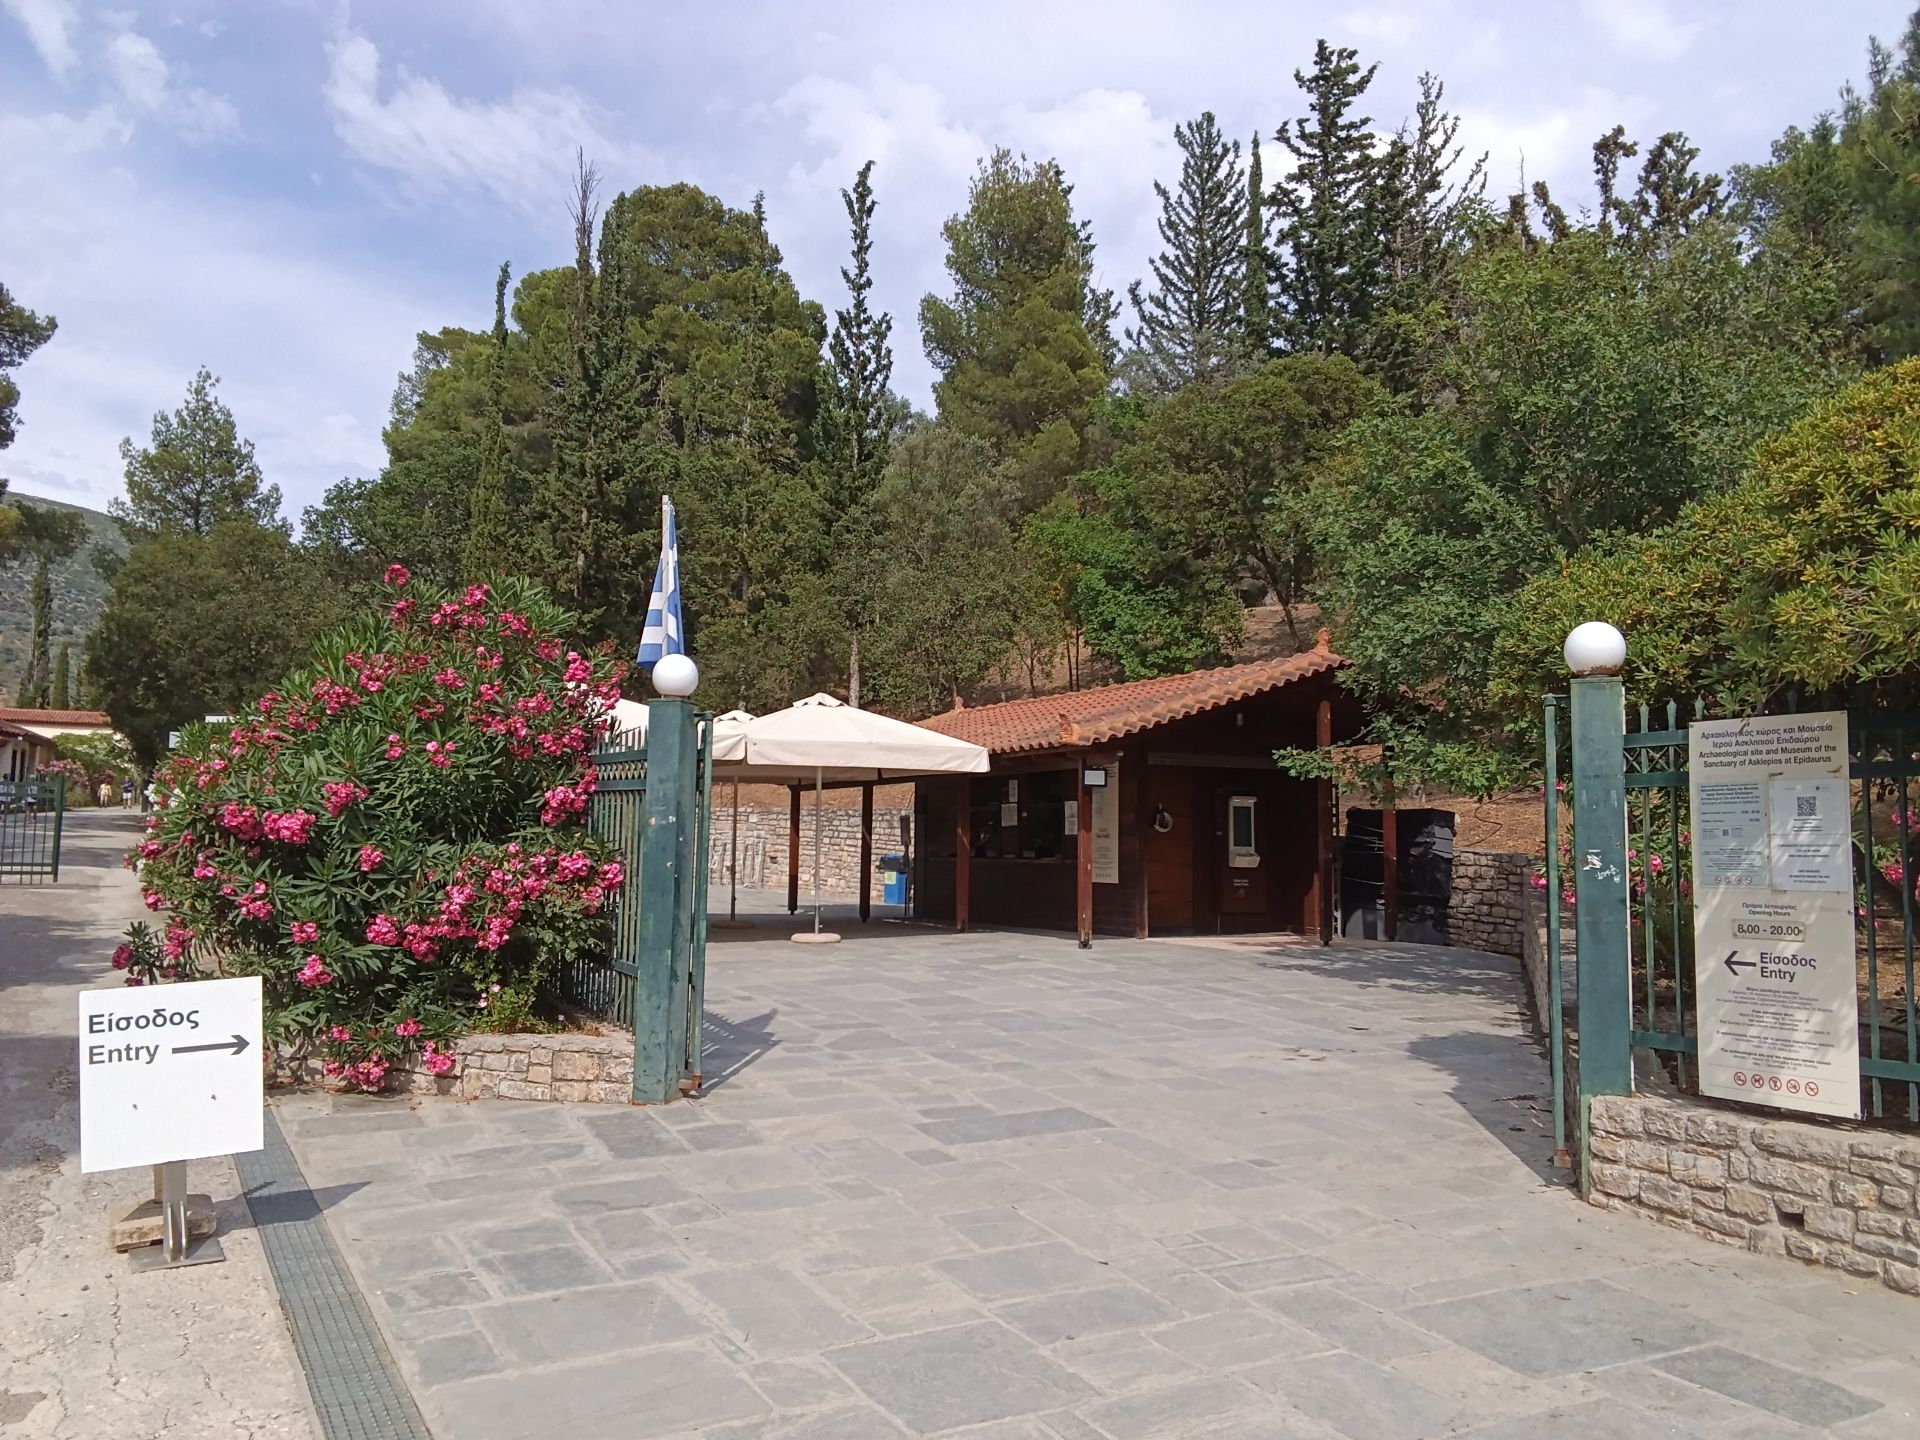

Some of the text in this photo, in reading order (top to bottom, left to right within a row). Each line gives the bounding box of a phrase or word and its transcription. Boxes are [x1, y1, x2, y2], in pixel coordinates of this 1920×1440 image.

[1755, 727, 1781, 736] χώρος
[1797, 724, 1833, 733] Μουσείο
[1712, 735, 1820, 749] Ιερού Ασκληπιού Επιδαύρου
[1699, 750, 1749, 759] Archaeological
[1780, 746, 1813, 755] Museum
[1814, 745, 1823, 753] of
[1823, 744, 1837, 752] the
[1703, 760, 1737, 769] Sanctuary
[1747, 757, 1783, 767] Asklepios
[1784, 756, 1793, 764] at
[1793, 755, 1832, 765] Epidaurus
[1748, 909, 1773, 917] Opening
[1760, 952, 1817, 970] Είσοδος
[1760, 966, 1796, 982] Entry
[88, 1008, 200, 1034] Είσοδος
[88, 1042, 160, 1065] Entry
